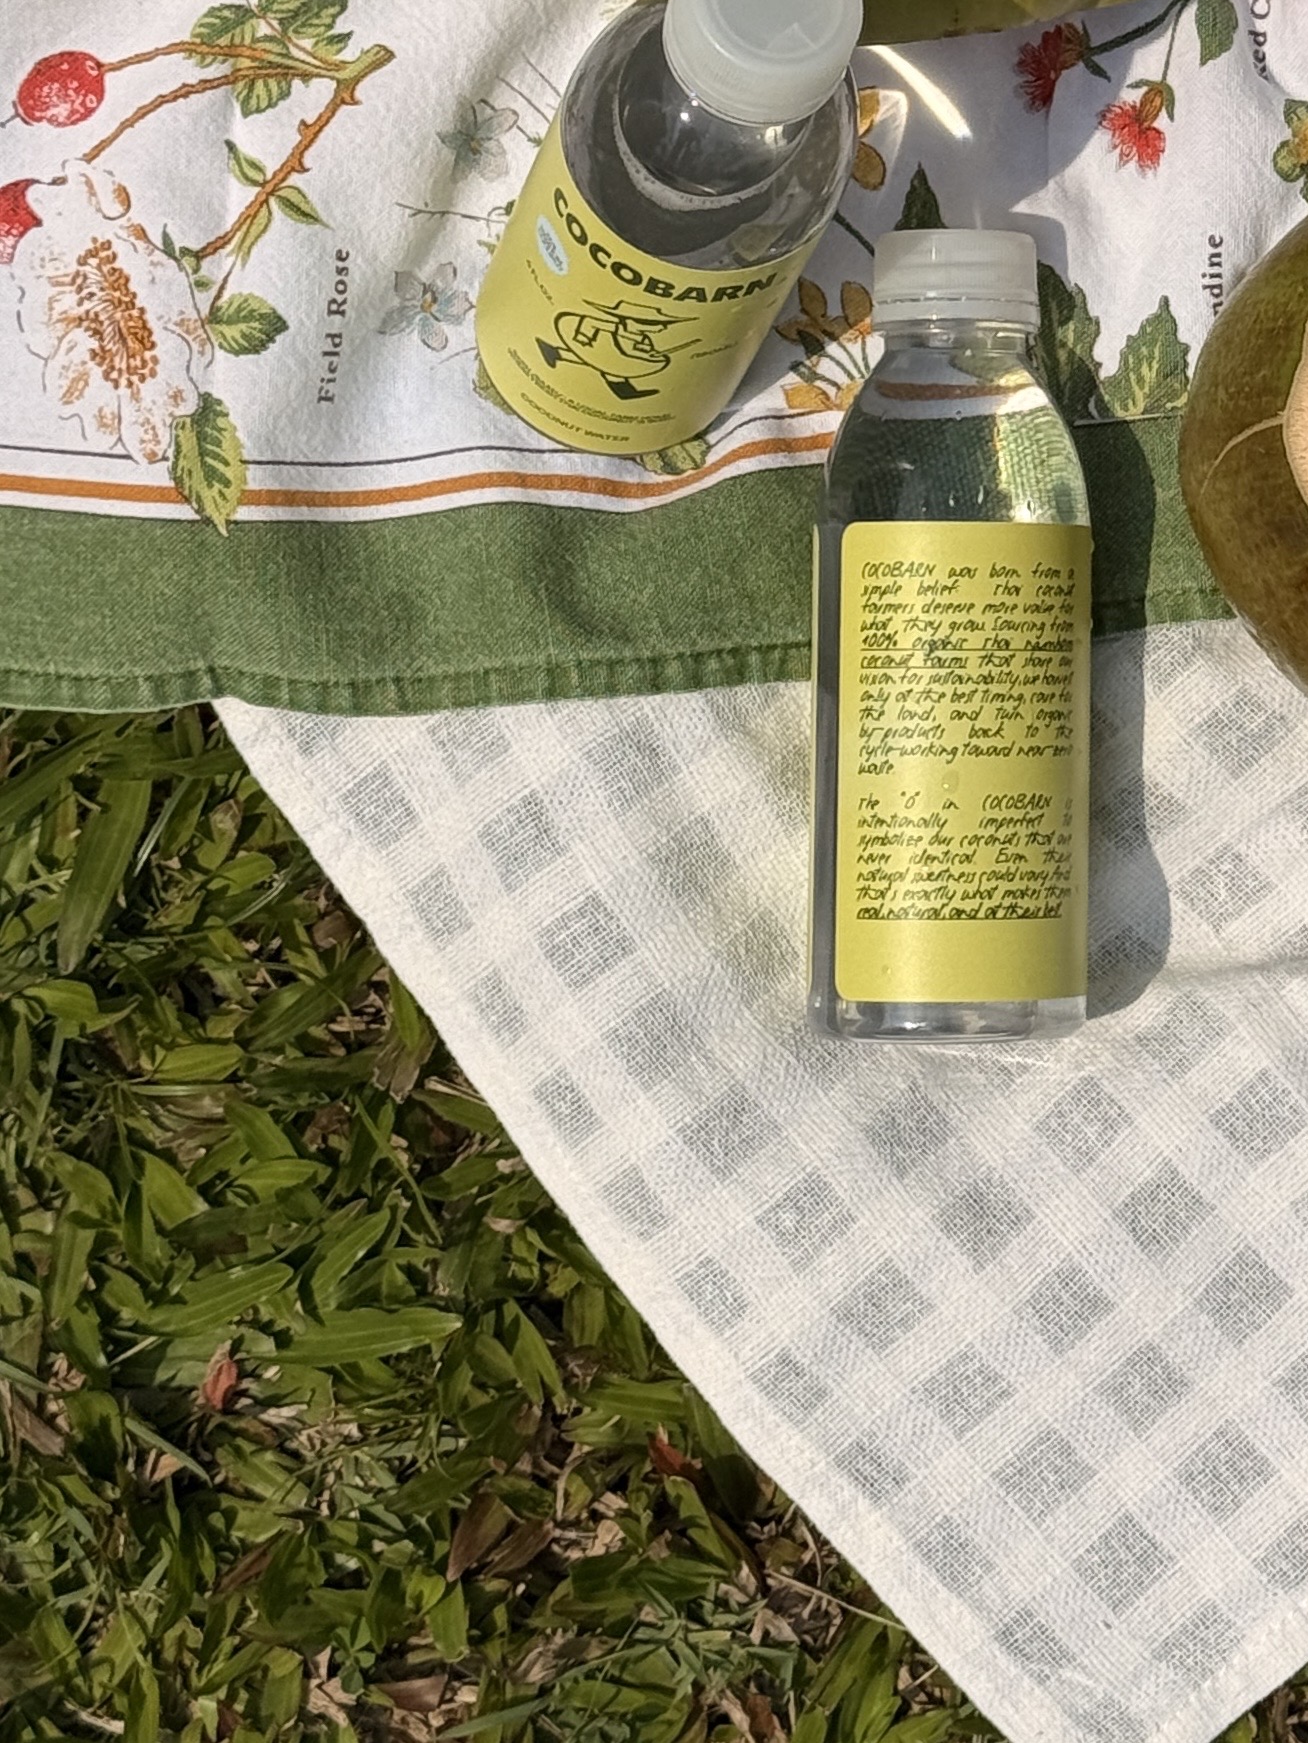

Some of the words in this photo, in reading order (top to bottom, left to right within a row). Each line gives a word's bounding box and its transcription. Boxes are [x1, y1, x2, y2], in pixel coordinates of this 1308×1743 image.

[553, 186, 778, 303] COCOBARN
[327, 246, 351, 319] Rose
[318, 331, 344, 405] Field
[520, 391, 583, 433] COCONUT
[583, 428, 631, 443] WATER
[861, 561, 937, 579] COCOBARN
[947, 567, 979, 578] was
[989, 562, 1022, 579] born
[1031, 562, 1062, 579] from
[860, 598, 915, 615] farmers
[920, 599, 976, 614] deserve
[981, 603, 1019, 614] more
[859, 616, 894, 632] what
[901, 617, 943, 636] they
[861, 634, 899, 648] 100%
[976, 653, 1017, 667] that
[858, 672, 897, 685] vision
[897, 668, 924, 685] for
[859, 690, 892, 707] only
[914, 689, 947, 704] the
[950, 687, 979, 704] best
[859, 707, 886, 722] the
[949, 706, 984, 722] and
[967, 722, 1006, 739] back
[1054, 724, 1075, 739] the
[959, 741, 1016, 757] toward
[857, 793, 881, 811] The
[982, 793, 1053, 812] COCOBARN
[856, 813, 949, 832] intentionally
[927, 833, 955, 846] our
[1024, 830, 1056, 845] that
[856, 853, 892, 865] never
[994, 848, 1030, 864] Even
[856, 869, 910, 886] natural
[977, 867, 1020, 885] could
[901, 885, 957, 904] exactly
[959, 884, 1000, 901] what
[1000, 885, 1043, 901] makes
[948, 902, 984, 918] and
